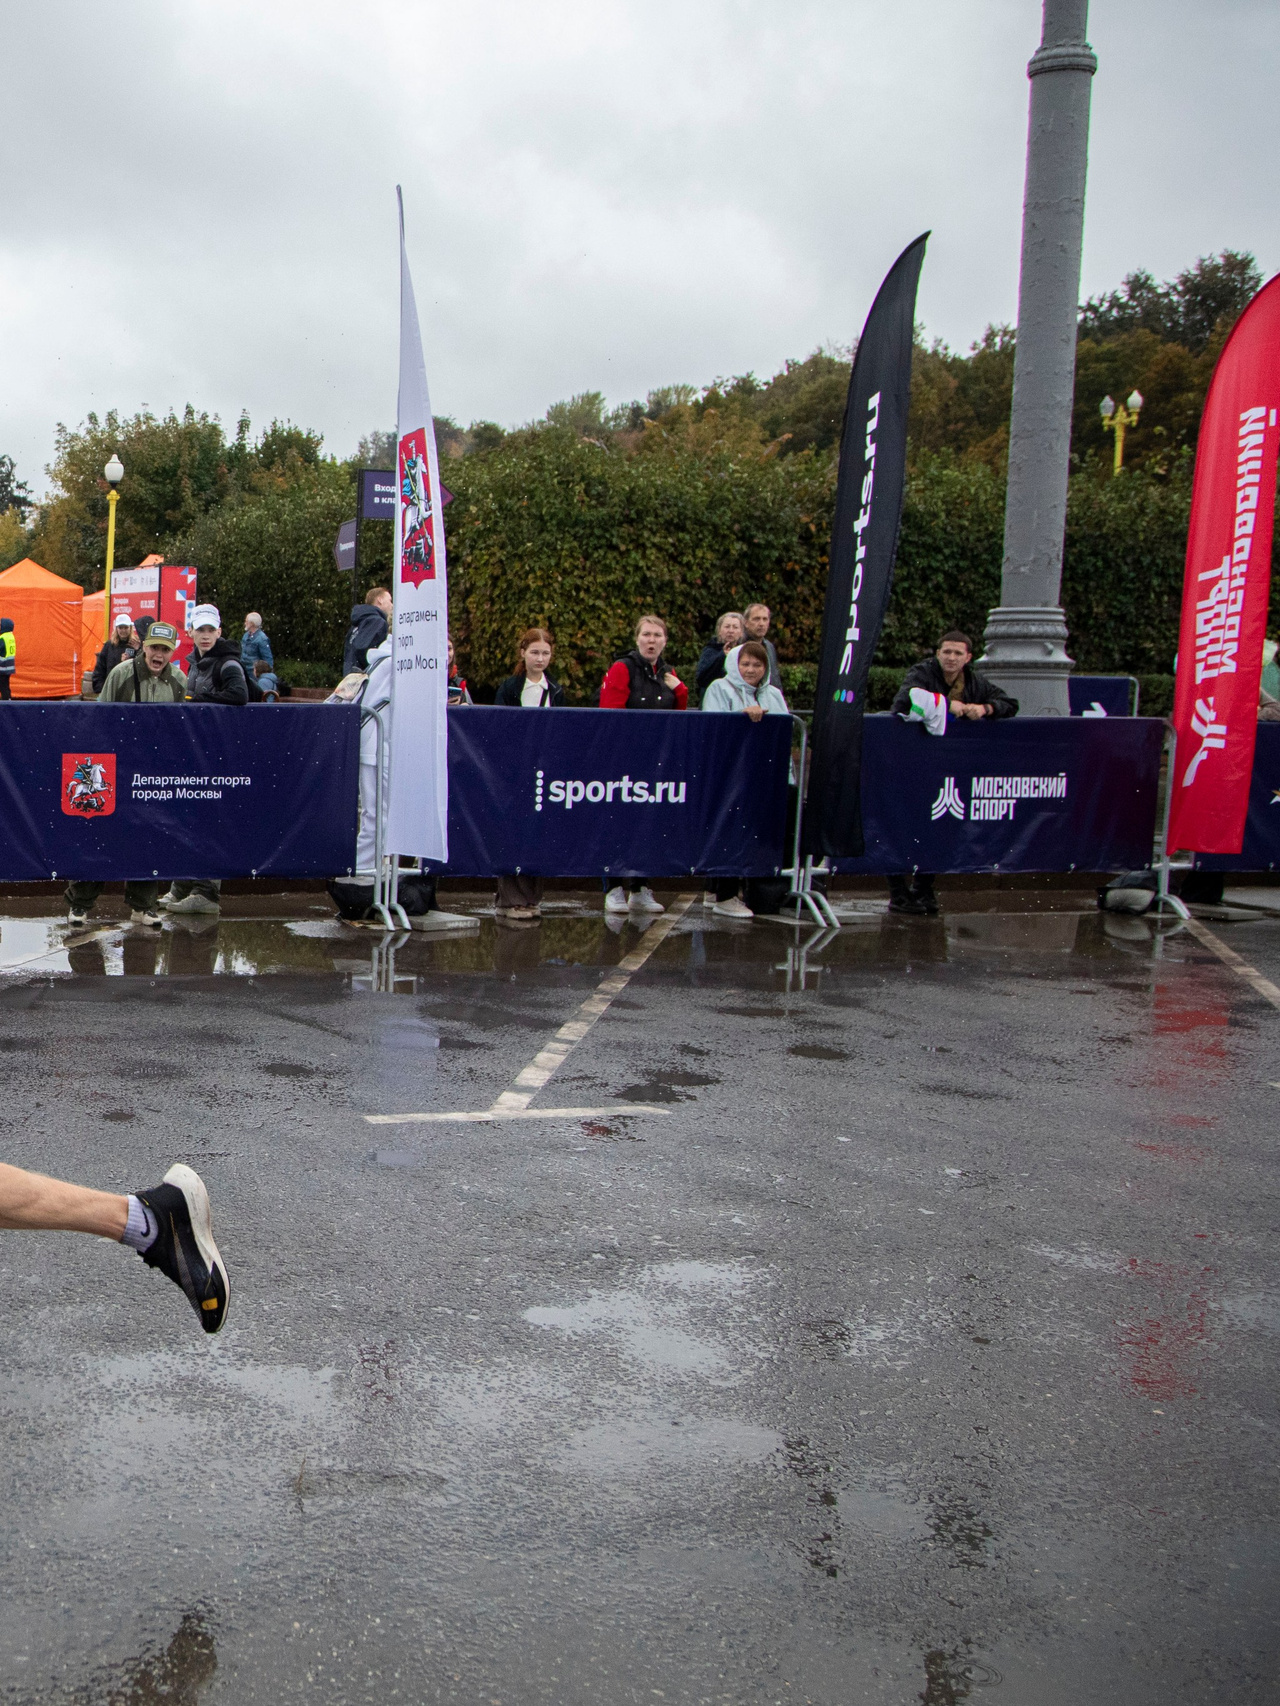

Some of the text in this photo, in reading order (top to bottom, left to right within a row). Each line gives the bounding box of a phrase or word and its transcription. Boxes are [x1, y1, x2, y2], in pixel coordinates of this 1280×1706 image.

[839, 391, 881, 675] sports.ru
[131, 774, 252, 787] Департамент спорта
[548, 775, 687, 809] sports.ru
[971, 772, 1067, 798] МОСКОВСКИЙ
[132, 788, 222, 801] города Москвы
[970, 799, 1017, 820] СПОРТ
